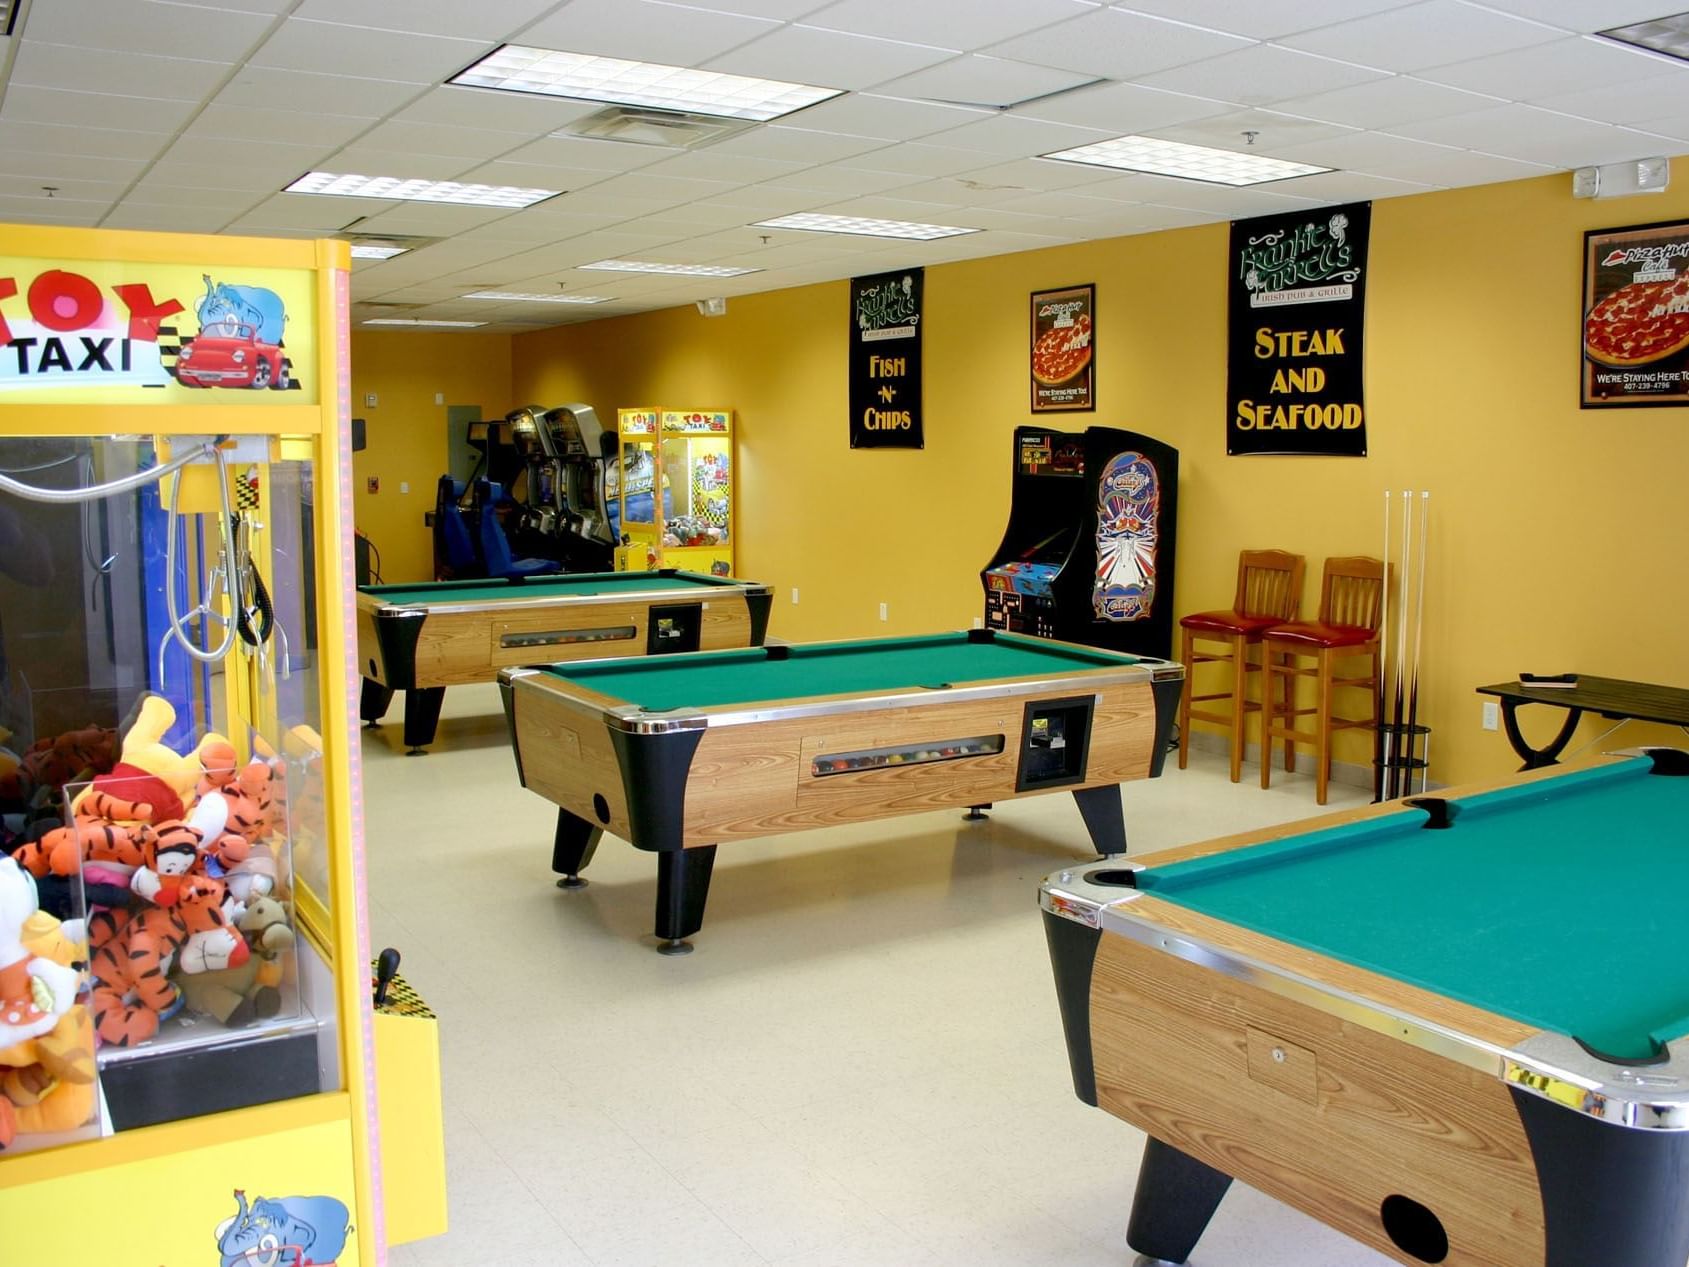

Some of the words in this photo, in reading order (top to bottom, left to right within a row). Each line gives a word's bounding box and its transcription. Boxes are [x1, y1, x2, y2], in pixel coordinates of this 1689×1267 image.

[1625, 248, 1662, 262] Pizza
[1254, 327, 1345, 359] STEAK
[7, 336, 132, 375] TAXI
[870, 355, 906, 378] FISH
[1269, 367, 1326, 394] AND
[1657, 371, 1681, 382] HERE
[683, 413, 712, 424] TOY
[864, 407, 911, 430] CHIPS
[1236, 400, 1362, 431] SEAFOOD
